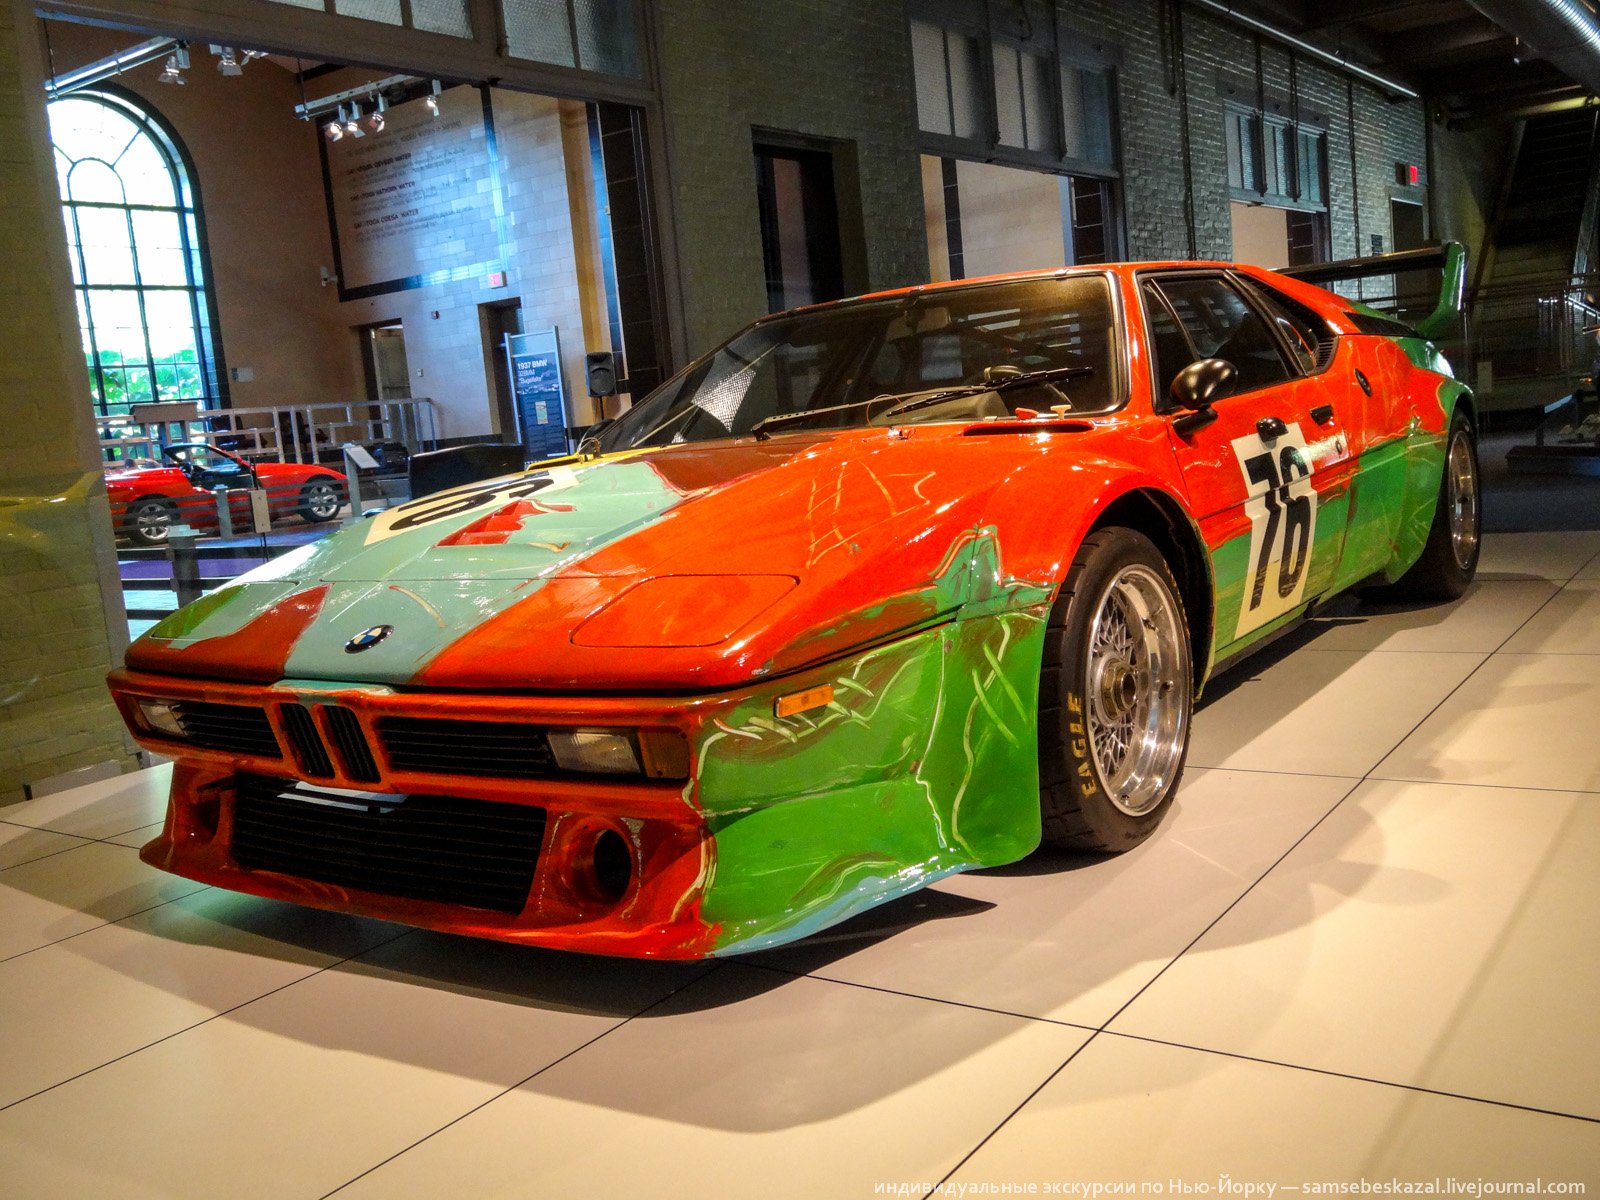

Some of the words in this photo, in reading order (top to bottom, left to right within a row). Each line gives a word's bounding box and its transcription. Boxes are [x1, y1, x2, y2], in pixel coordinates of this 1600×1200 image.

[517, 361, 531, 370] 1937
[532, 359, 548, 368] BMW
[1244, 445, 1312, 612] 76
[1067, 692, 1097, 798] EAGLE
